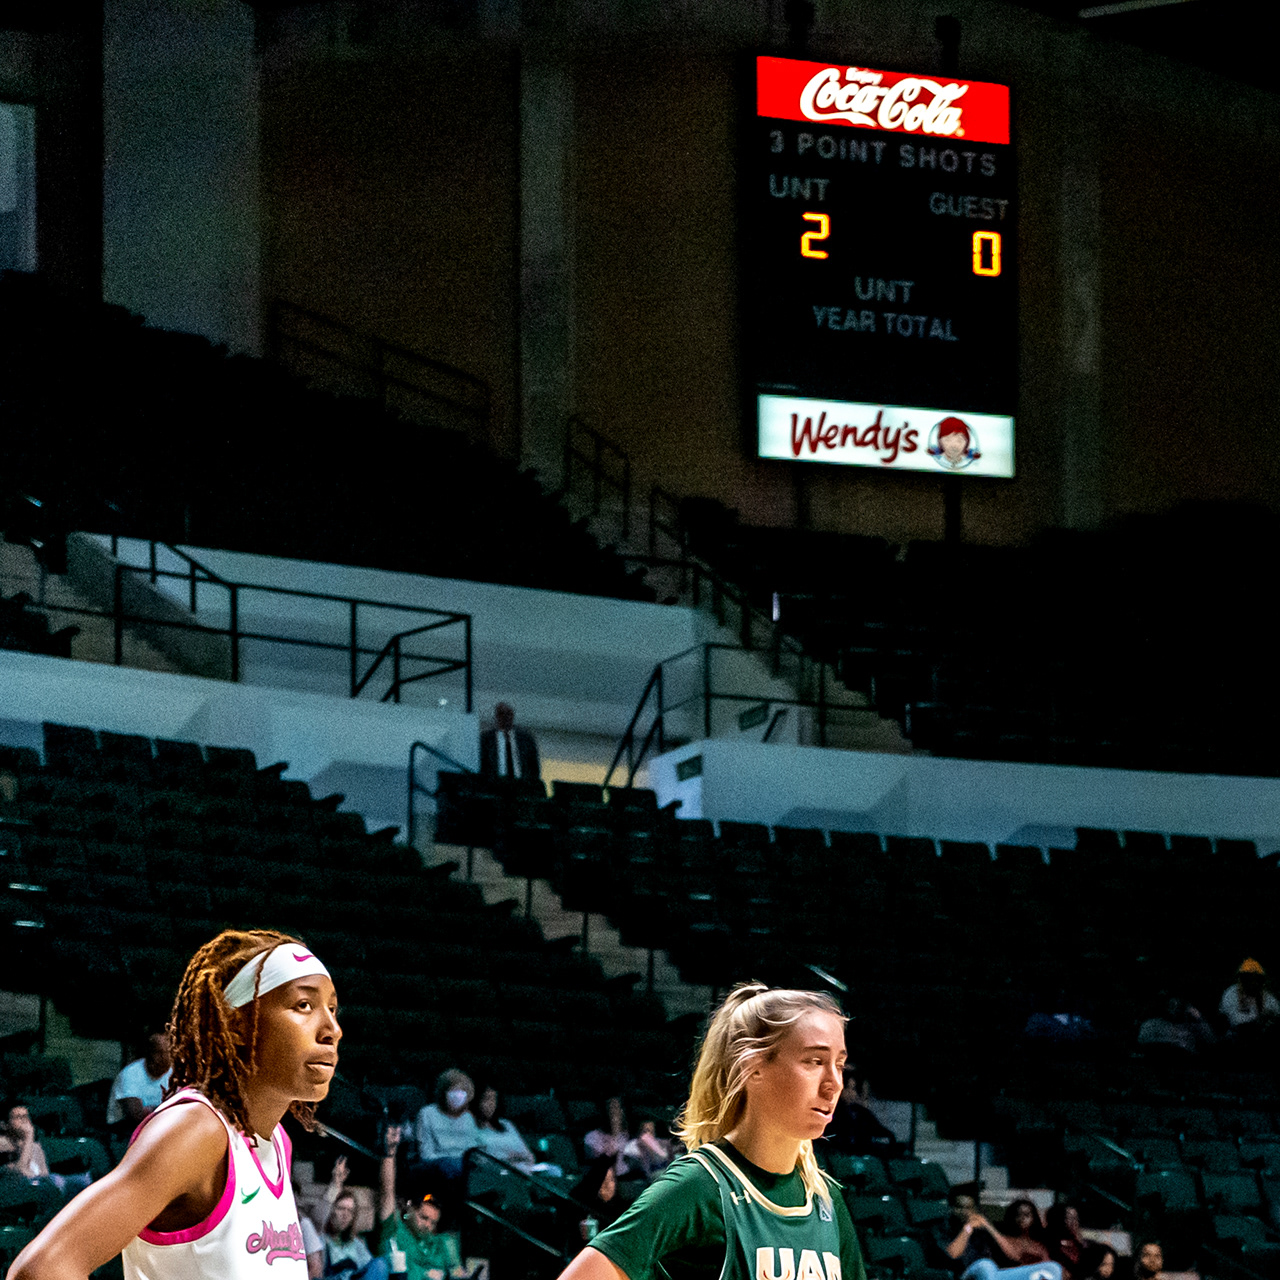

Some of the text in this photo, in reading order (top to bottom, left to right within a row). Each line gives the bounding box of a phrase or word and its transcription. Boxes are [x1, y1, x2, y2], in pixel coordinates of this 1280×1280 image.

[769, 130, 997, 177] 3 POINT SHOTS
[768, 174, 831, 201] UNT
[928, 192, 1009, 220] GUEST
[801, 211, 1002, 277] 2 0
[854, 275, 915, 304] UNT
[812, 304, 959, 342] YEAR TOTAL
[790, 410, 919, 465] Wendy's
